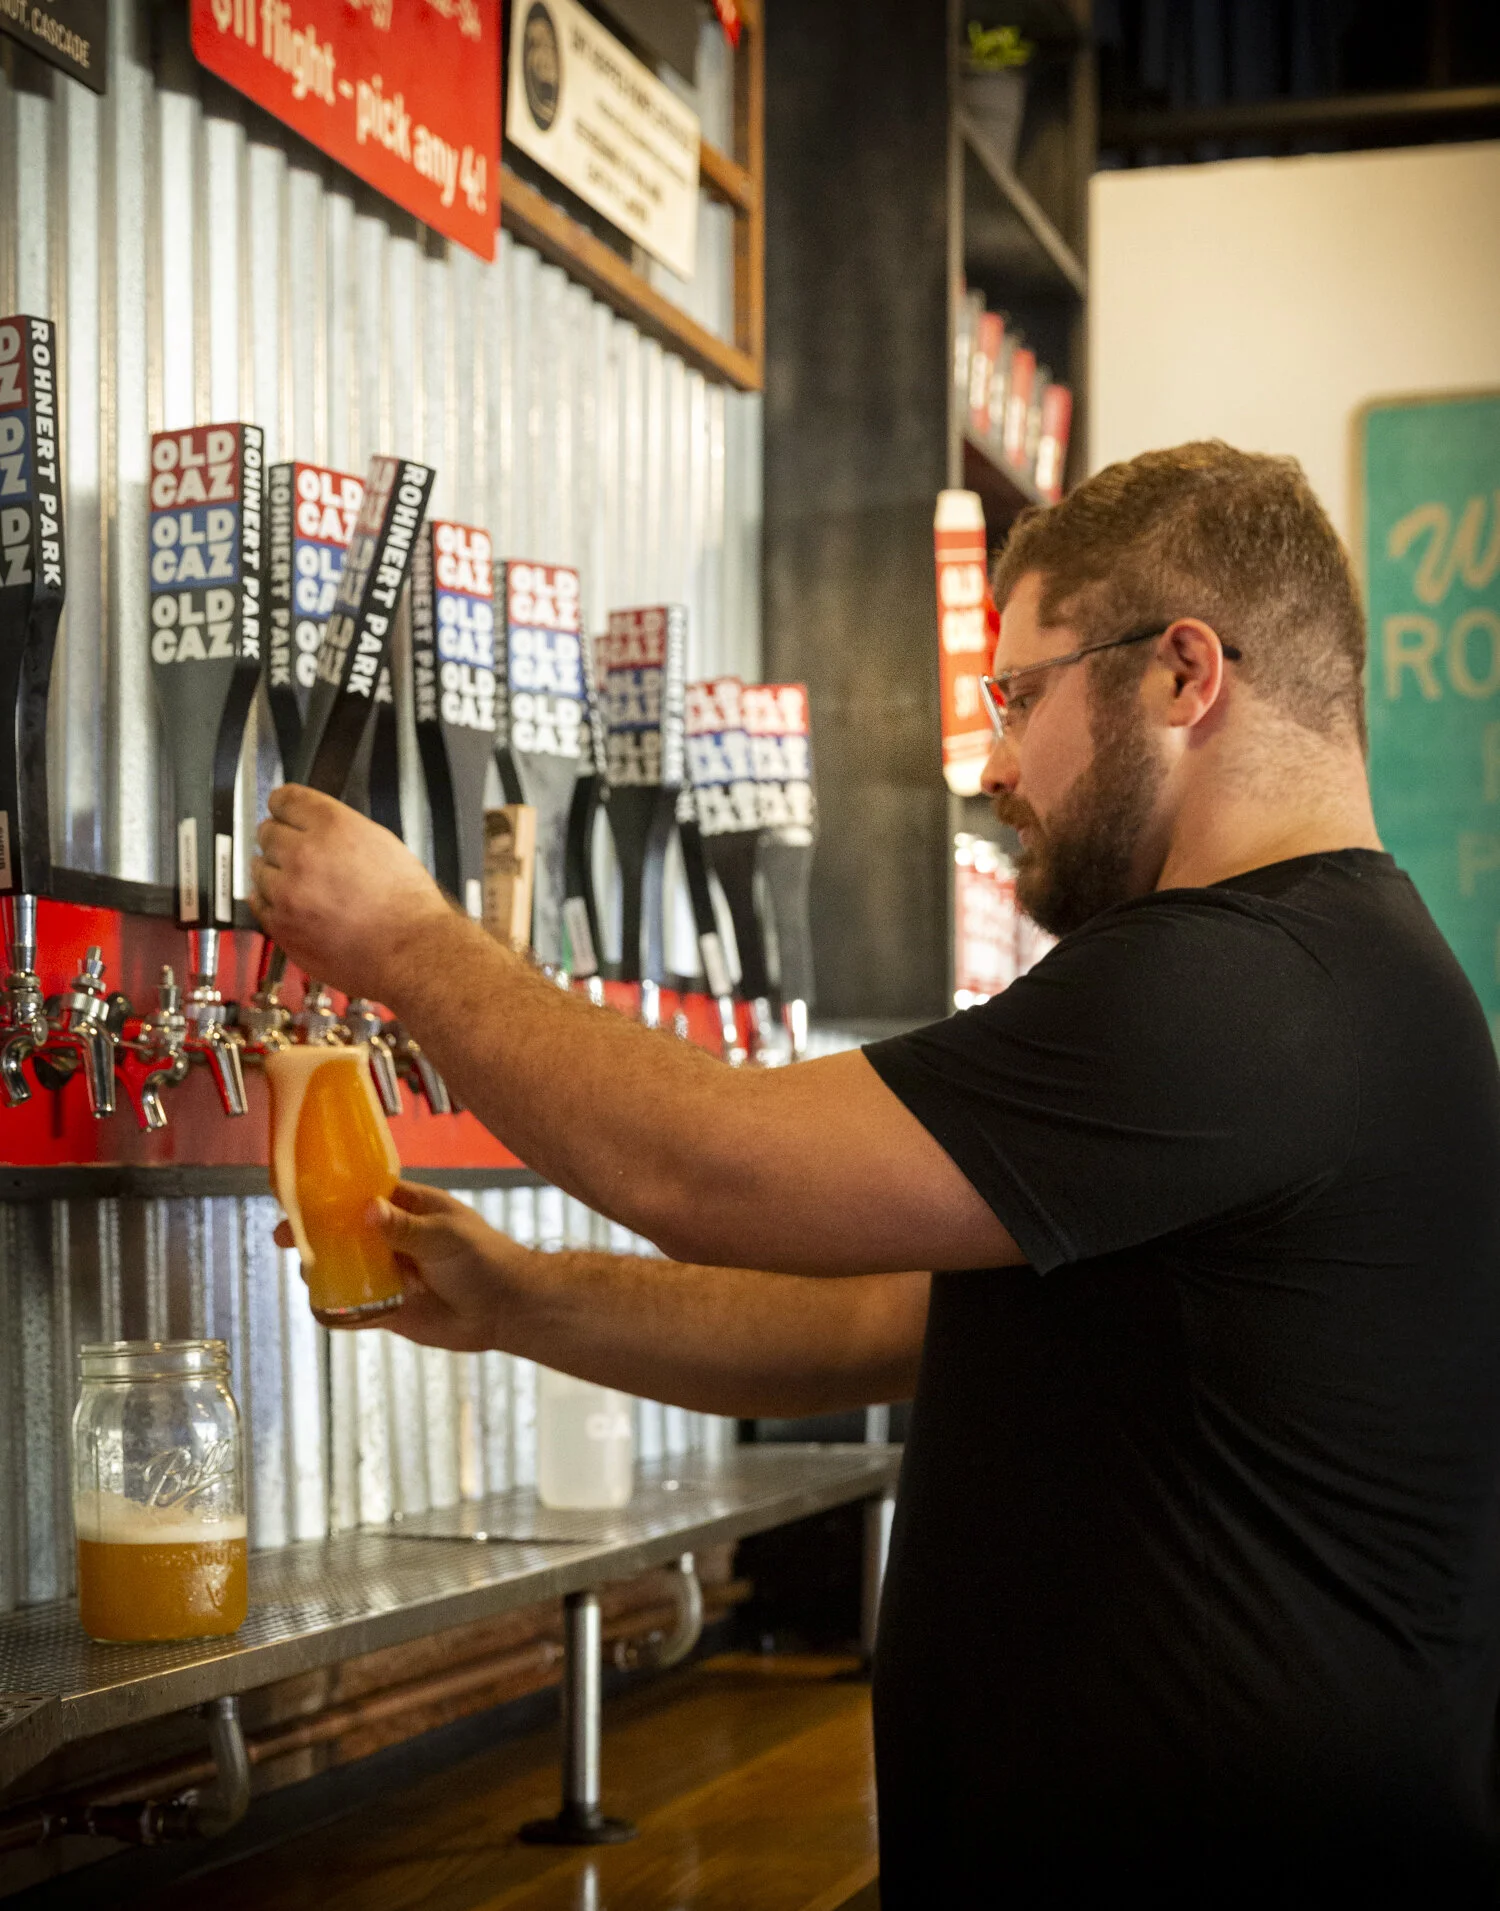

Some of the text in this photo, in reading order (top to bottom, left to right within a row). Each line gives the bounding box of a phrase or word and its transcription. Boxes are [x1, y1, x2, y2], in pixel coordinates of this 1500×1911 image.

[31, 7, 90, 68] CASCADE
[261, 0, 336, 106] flight
[356, 73, 412, 164] pick
[413, 124, 459, 208] any
[30, 320, 62, 586] ROHNERT PARK
[152, 430, 236, 473] OLD
[151, 462, 235, 508] CAZ
[296, 468, 364, 513] OLD
[152, 508, 236, 548] OLD
[241, 426, 263, 660] ROHNERT PARK
[371, 462, 429, 609] ROHNERT
[436, 523, 492, 562] OLD
[151, 543, 234, 585] CAZ
[295, 544, 348, 584] OL
[509, 563, 579, 600] OLD
[151, 588, 235, 628] OLD
[437, 595, 494, 633] OLD
[150, 621, 234, 664] CAZ
[270, 607, 291, 687] PARK
[346, 612, 389, 698] PARK
[509, 628, 581, 666] OLD
[440, 660, 496, 698] OLD
[511, 692, 582, 728] OLD
